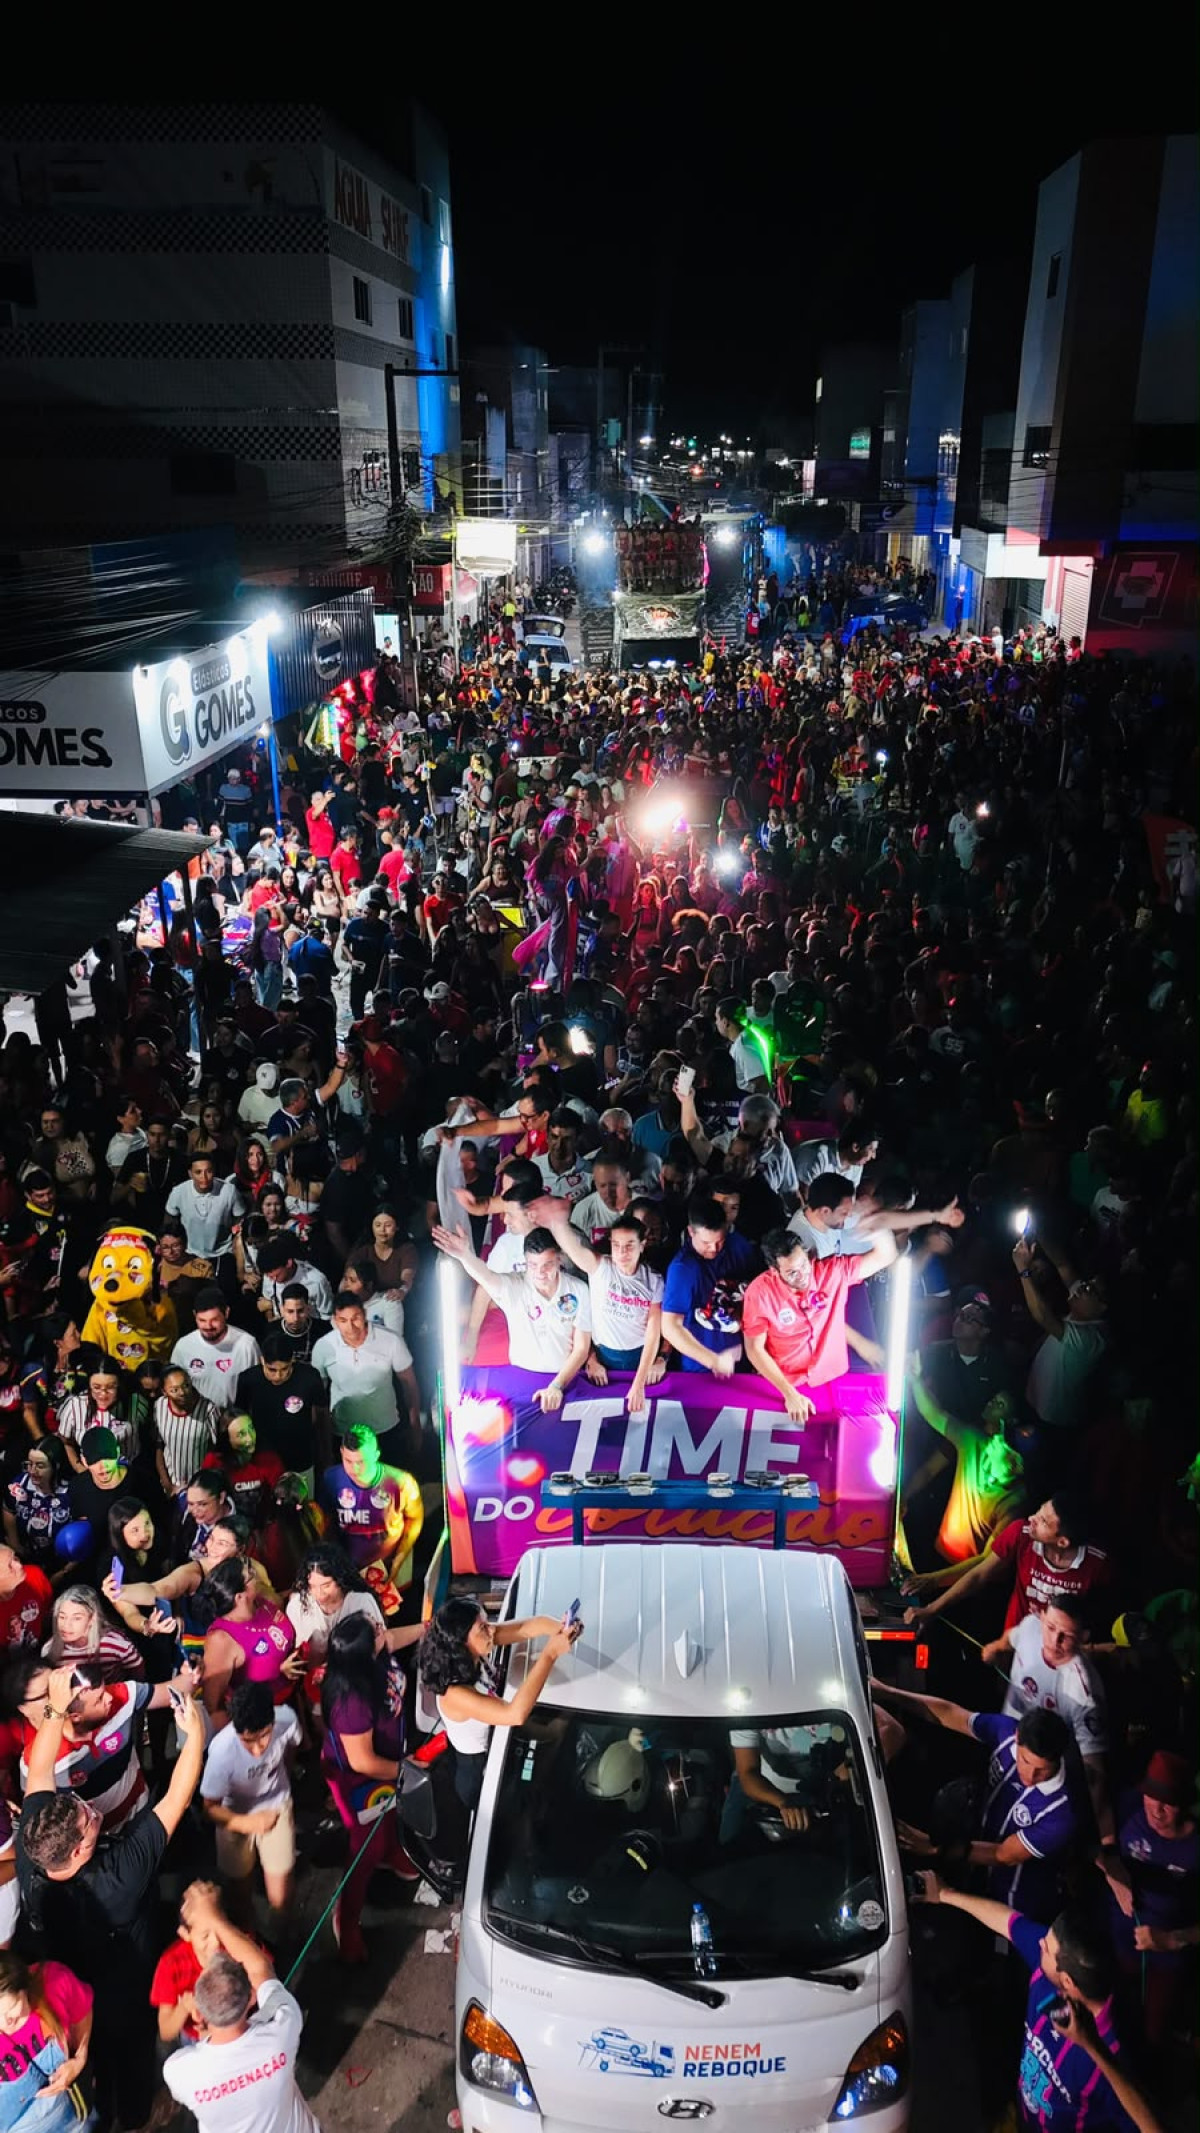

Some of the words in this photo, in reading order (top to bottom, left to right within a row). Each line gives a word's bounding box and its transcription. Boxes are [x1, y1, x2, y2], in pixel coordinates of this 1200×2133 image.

[195, 675, 256, 749] GOMES
[561, 1397, 805, 1484] TIME
[337, 1508, 370, 1525] TIME
[473, 1495, 536, 1522] DO
[684, 2042, 761, 2061] NENEM
[194, 2052, 287, 2103] COORDENAÇÃO
[683, 2056, 786, 2078] REBOQUE
